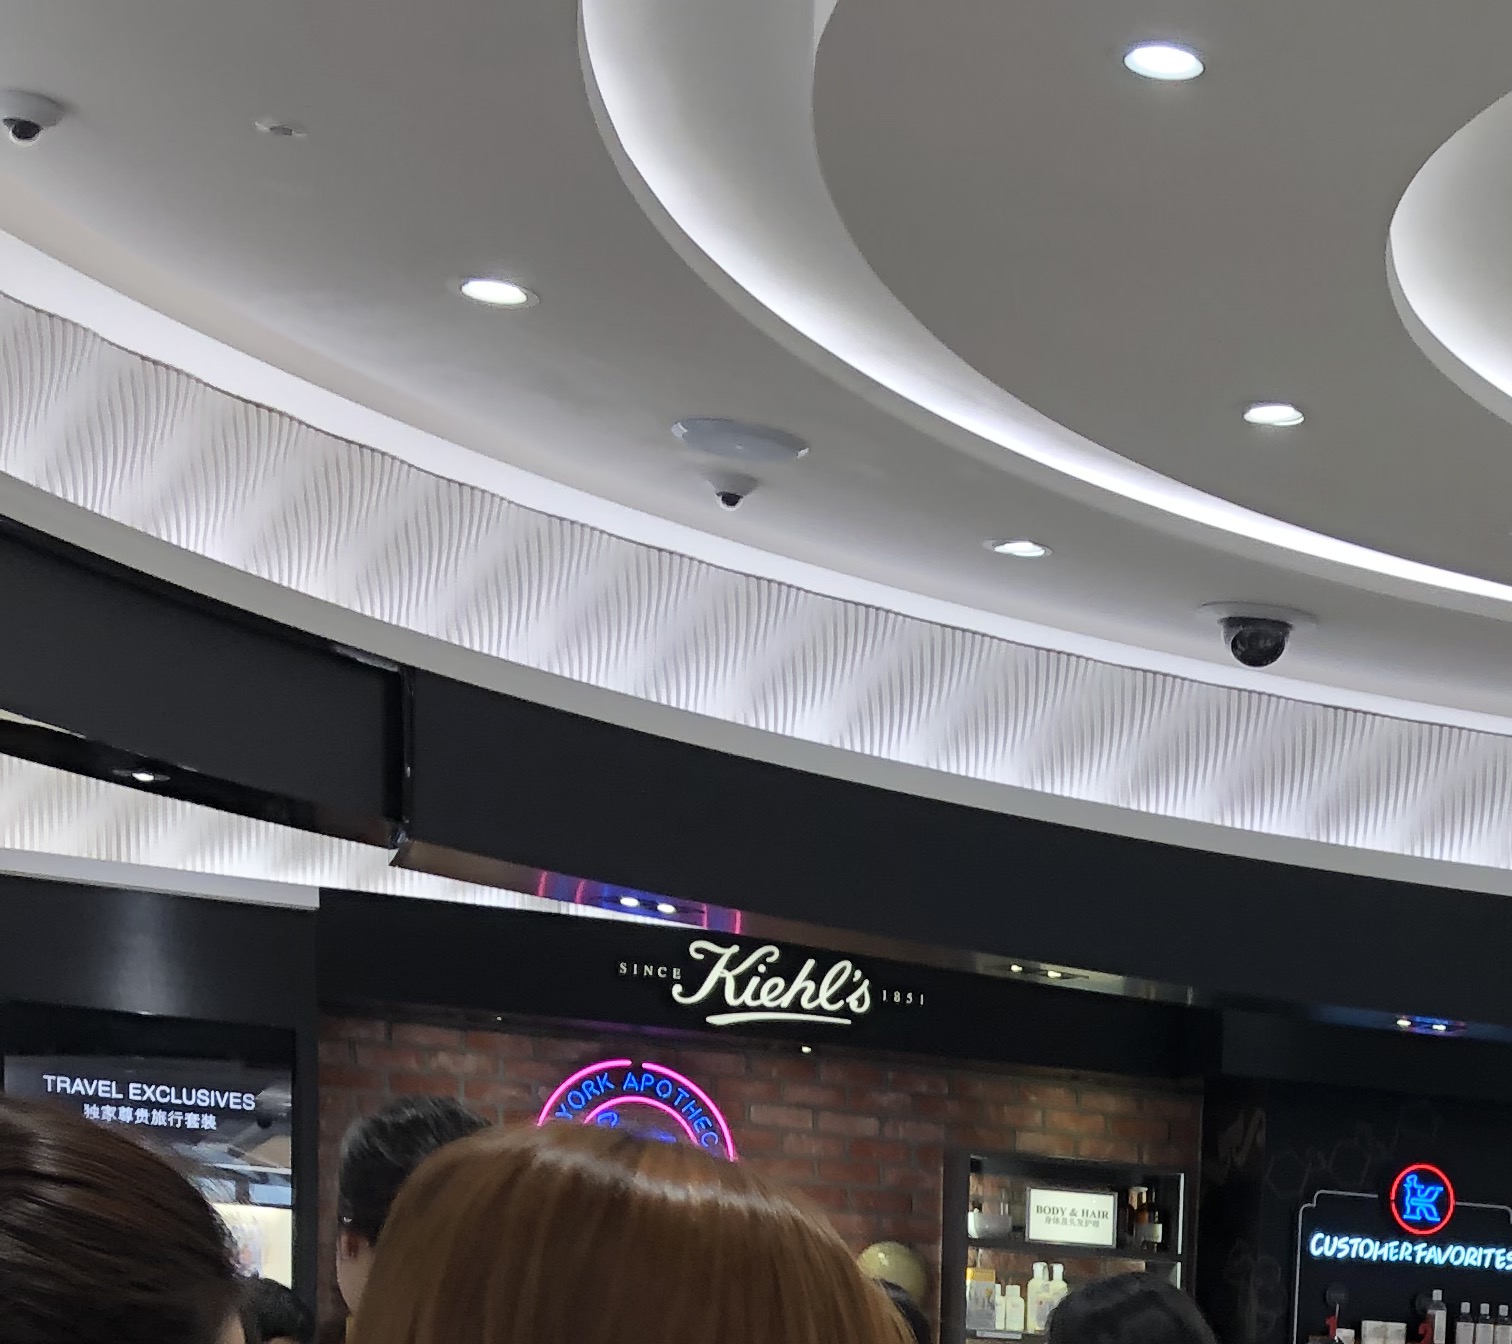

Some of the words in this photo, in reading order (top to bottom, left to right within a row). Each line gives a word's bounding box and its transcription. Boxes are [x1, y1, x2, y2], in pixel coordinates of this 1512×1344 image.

[618, 962, 682, 980] SINCE
[671, 940, 871, 1014] Kiehl's
[882, 989, 926, 1006] 1851
[43, 1074, 124, 1099] TRAVEL
[129, 1083, 255, 1111] EXCLUSIVES
[555, 1072, 615, 1120] YORK
[1036, 1204, 1067, 1216] BODY
[1069, 1207, 1078, 1217] &
[1081, 1208, 1109, 1220] HAIR
[1310, 1231, 1412, 1263] CUSTOMER
